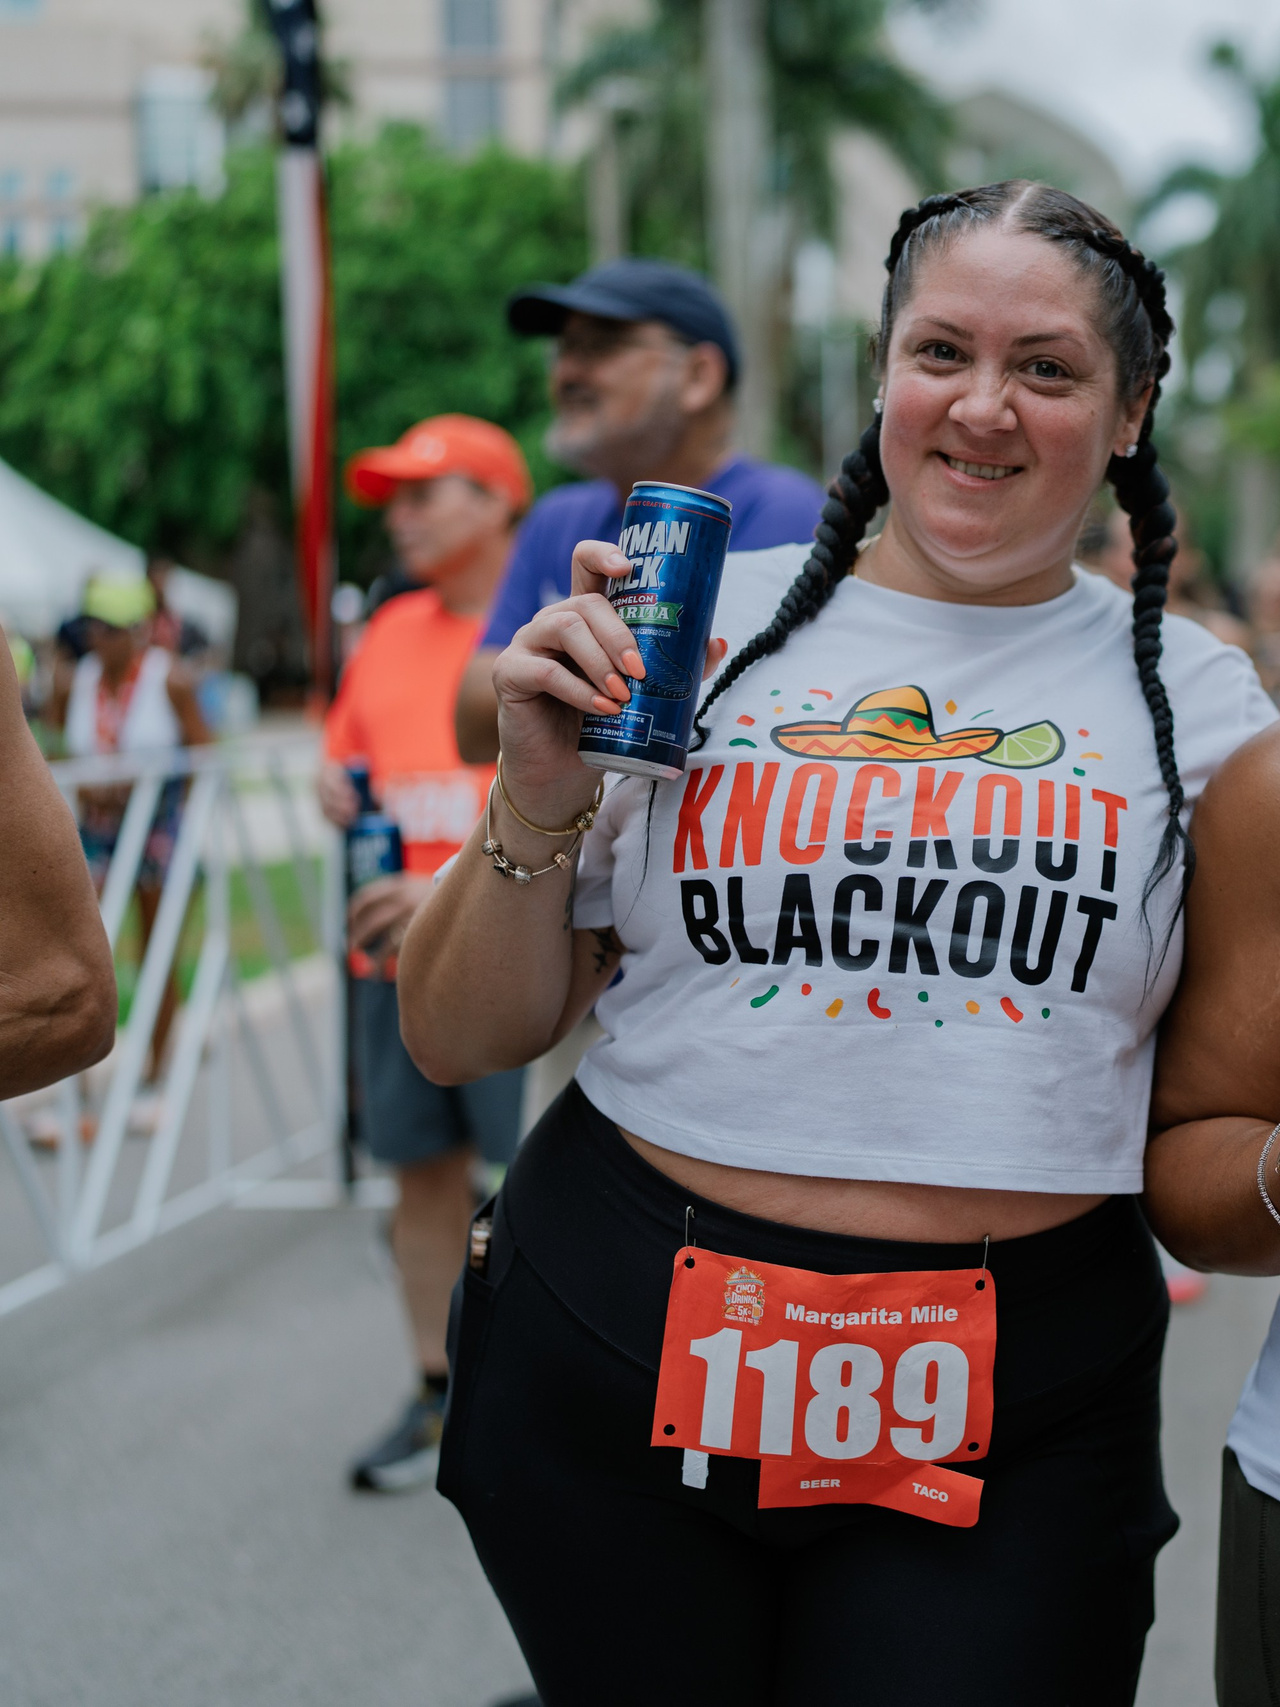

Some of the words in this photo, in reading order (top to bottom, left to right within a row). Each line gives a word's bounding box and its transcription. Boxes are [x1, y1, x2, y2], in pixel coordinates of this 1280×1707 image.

[608, 556, 663, 597] ACK
[611, 594, 654, 608] ERMELON
[618, 606, 669, 620] ARITA
[626, 714, 645, 723] JUICE
[602, 729, 625, 737] DRINK
[673, 761, 1128, 892] KNOCKOUT
[680, 873, 1118, 993] BLACKOUT
[735, 1284, 756, 1293] CINCO
[731, 1291, 758, 1304] DRINKO
[785, 1303, 903, 1329] Margarita
[910, 1305, 959, 1324] Mile
[689, 1327, 970, 1461] 1189
[800, 1479, 841, 1489] BEER
[912, 1482, 949, 1503] TACO
